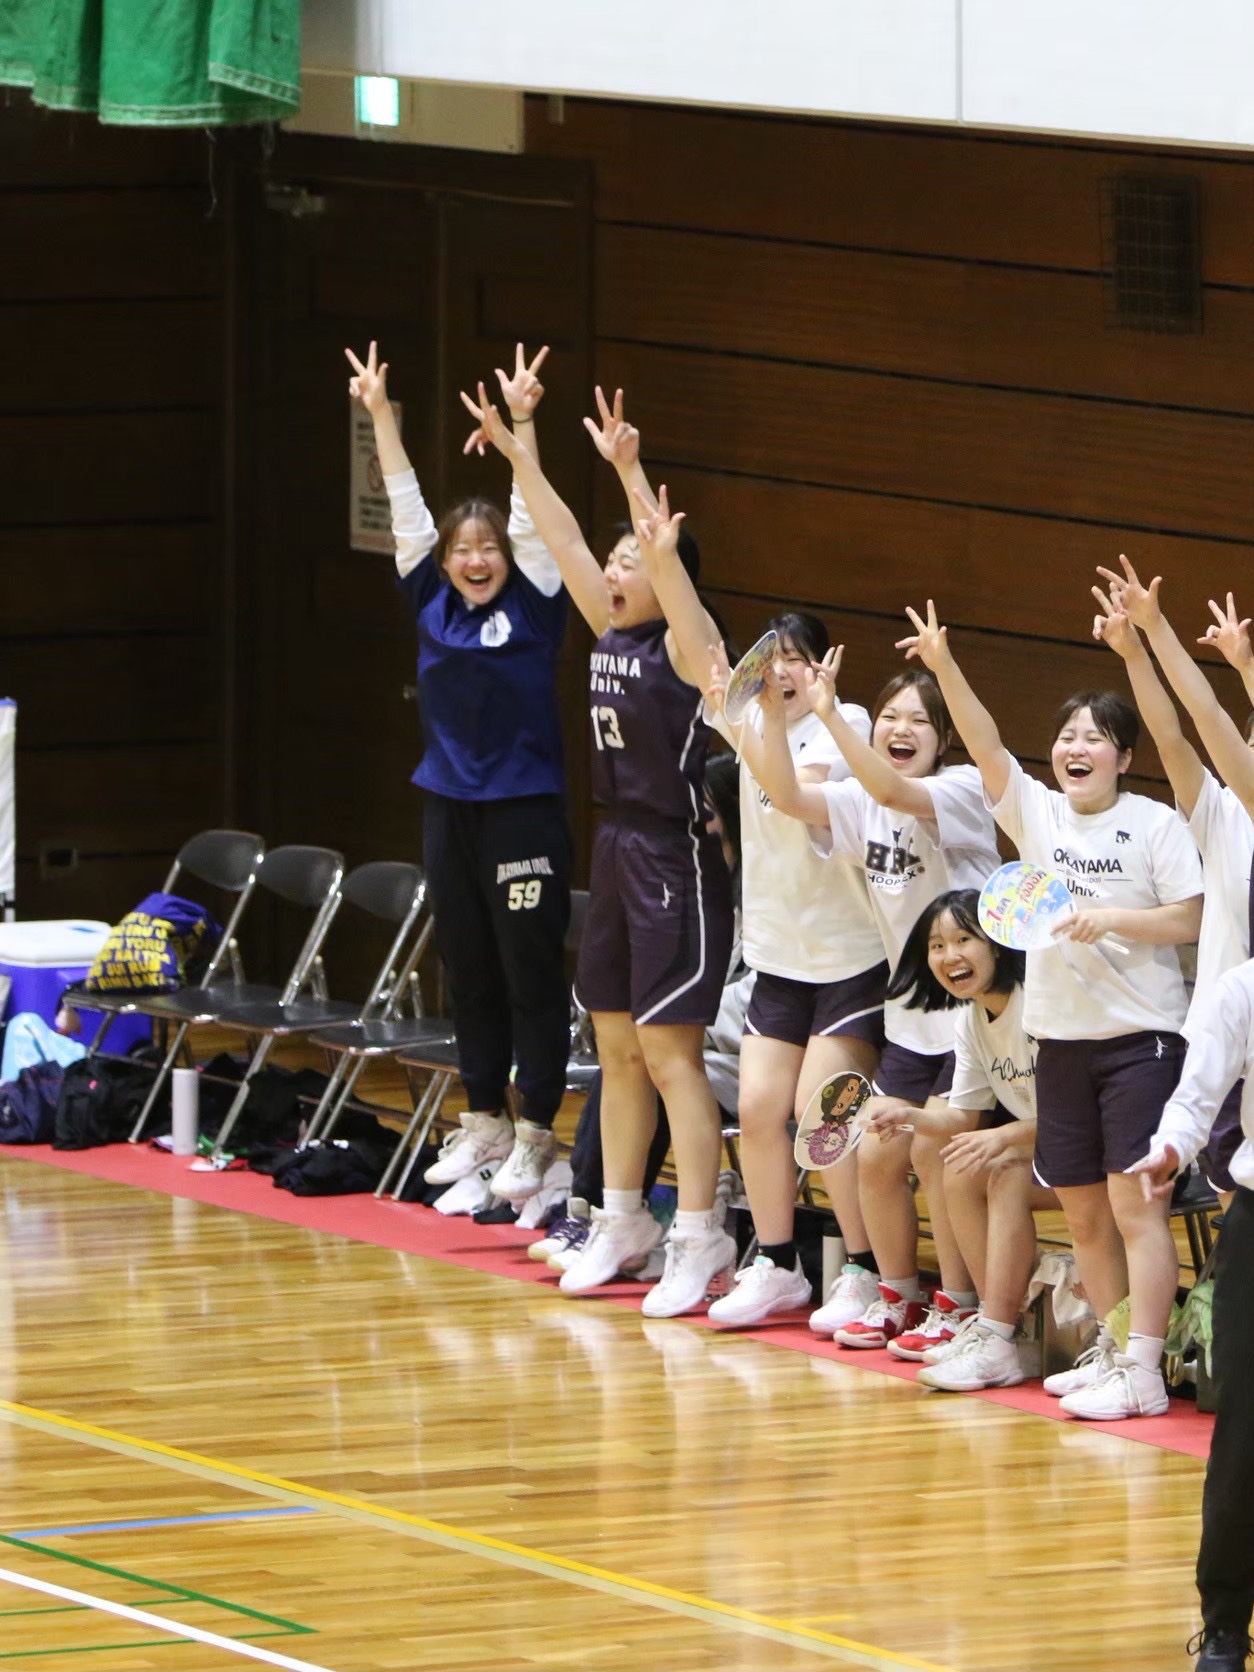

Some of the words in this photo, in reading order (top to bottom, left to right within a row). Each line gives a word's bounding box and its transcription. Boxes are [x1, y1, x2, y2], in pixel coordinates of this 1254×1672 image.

[591, 705, 625, 751] 13
[1054, 848, 1122, 873] OKAYAMA
[508, 880, 542, 911] 59
[1066, 878, 1099, 897] Univ.
